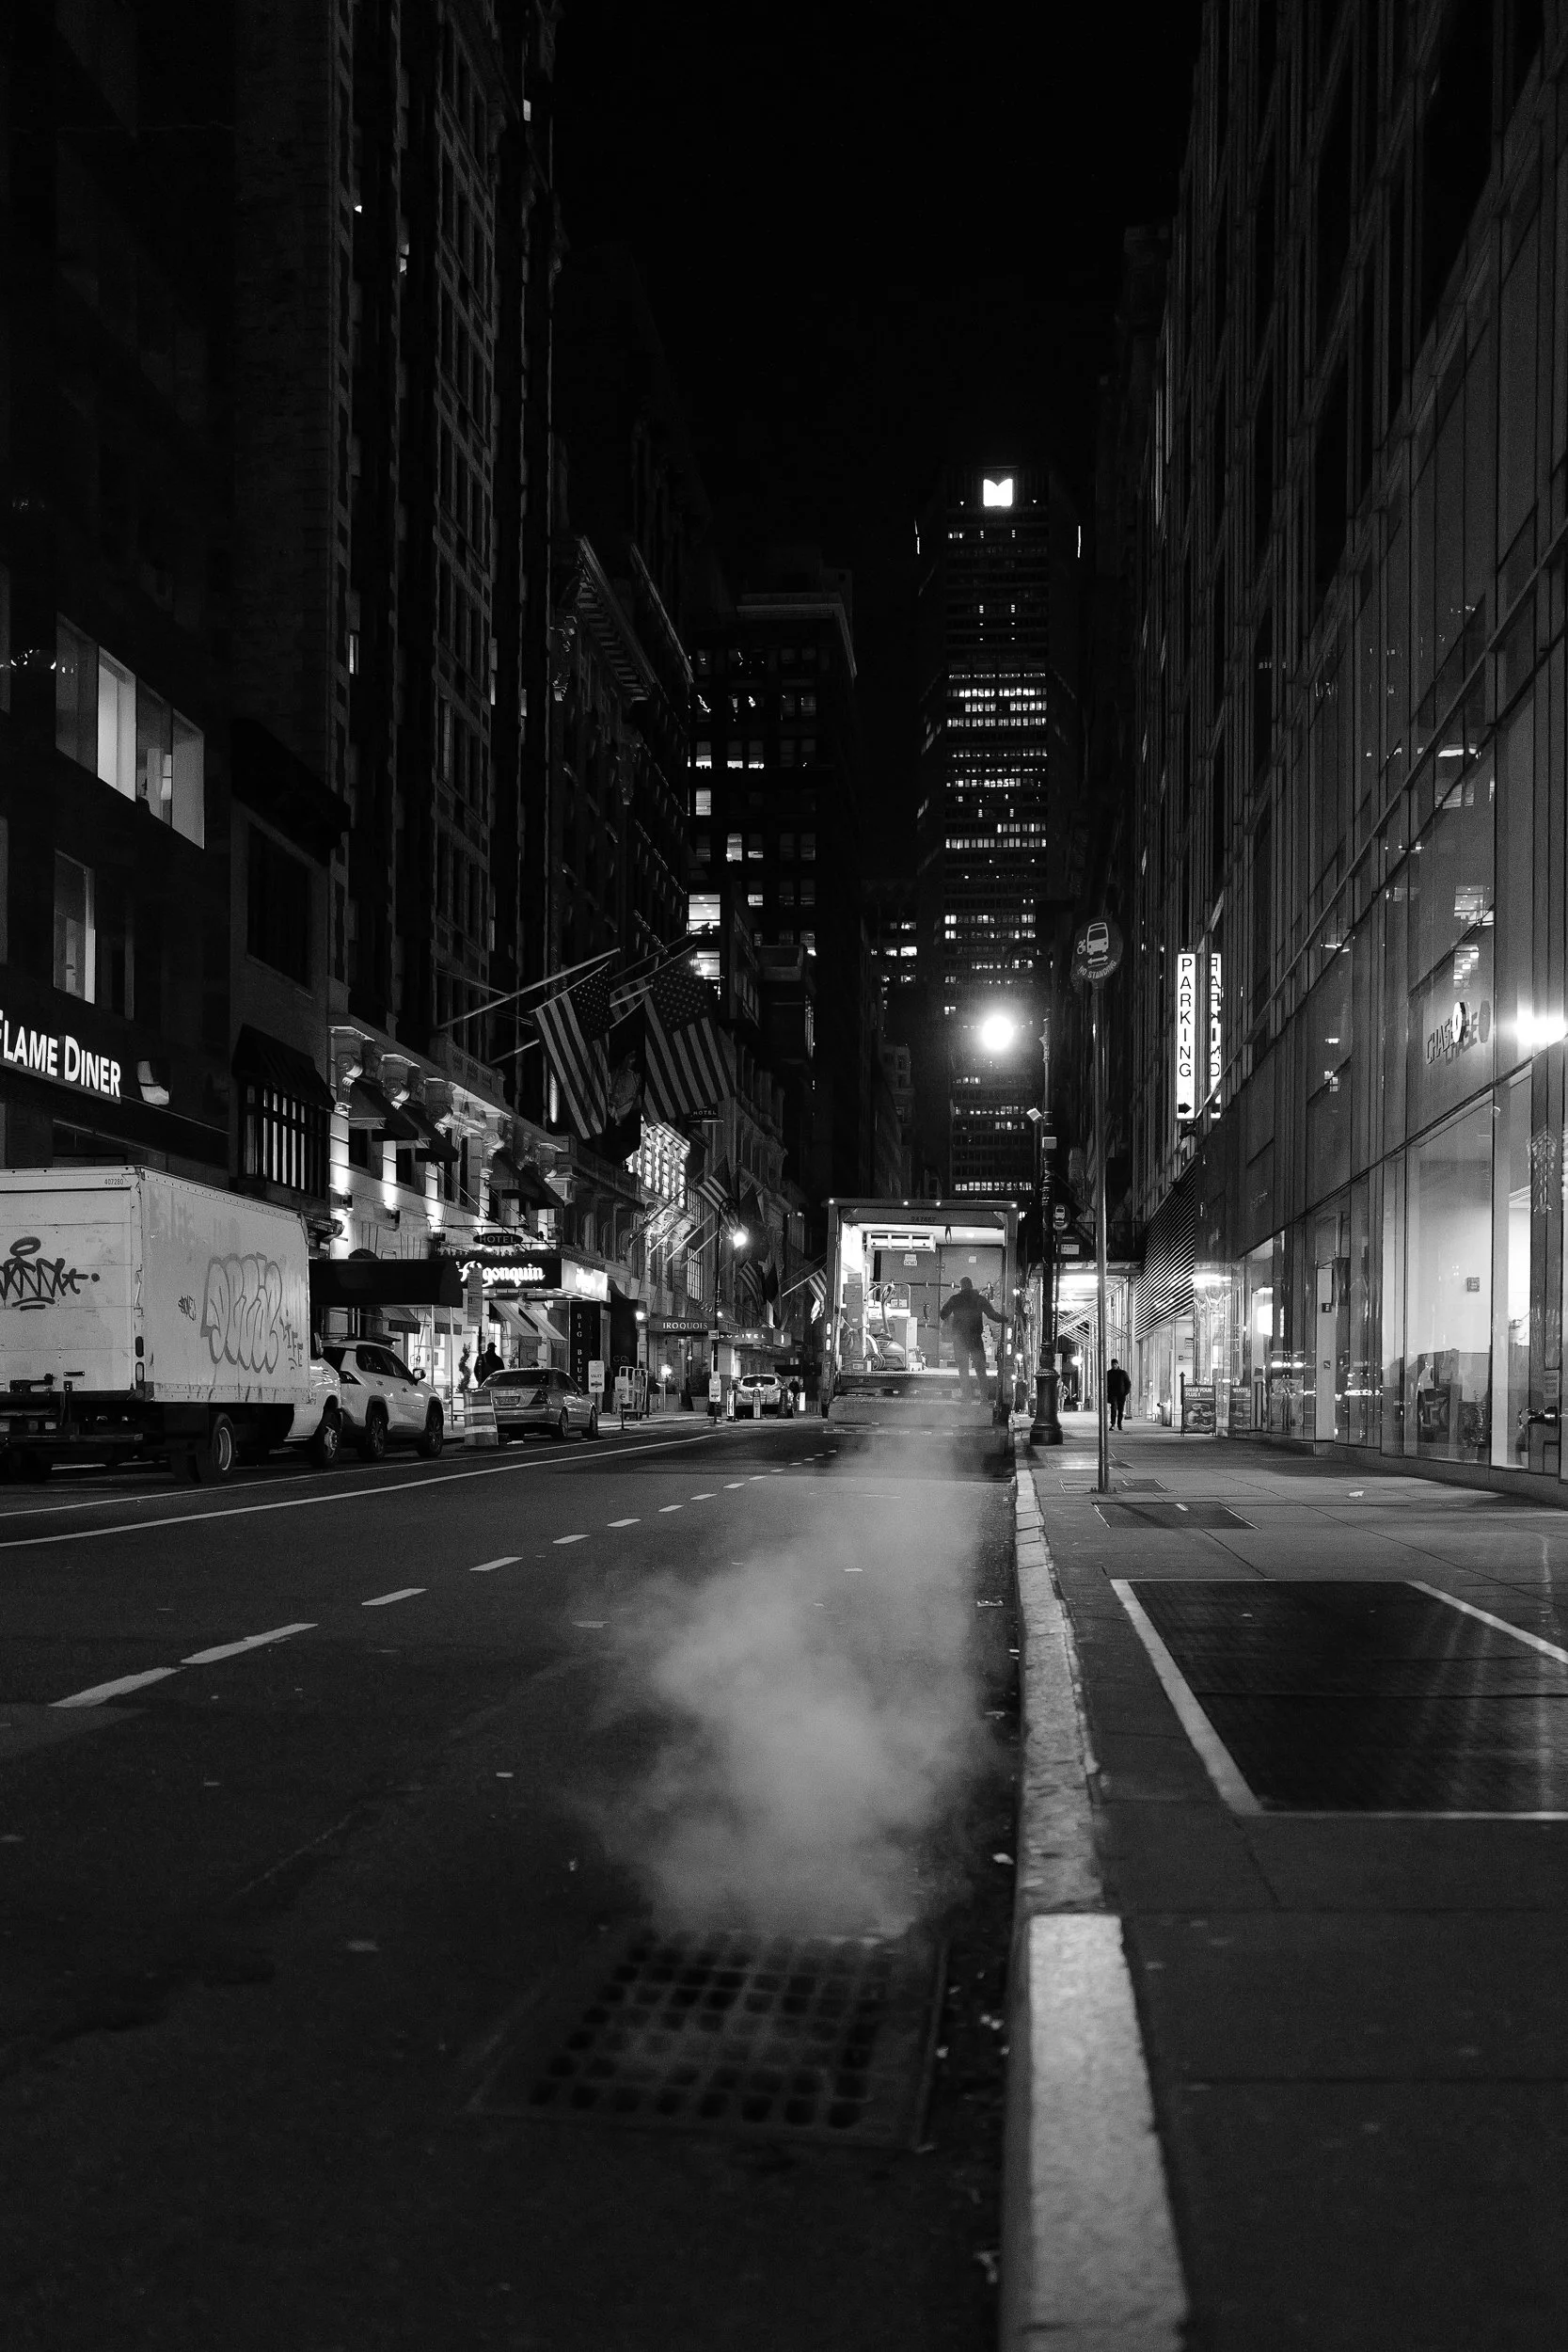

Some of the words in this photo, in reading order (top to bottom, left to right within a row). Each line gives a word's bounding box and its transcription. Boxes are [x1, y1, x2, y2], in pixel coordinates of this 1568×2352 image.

[1077, 965, 1087, 976] NO
[1087, 960, 1117, 979] STANDING
[1179, 958, 1193, 1077] PARKING
[0, 1009, 58, 1077] LAME
[480, 1235, 516, 1244] HOTEL
[455, 1261, 546, 1287] Agonquin
